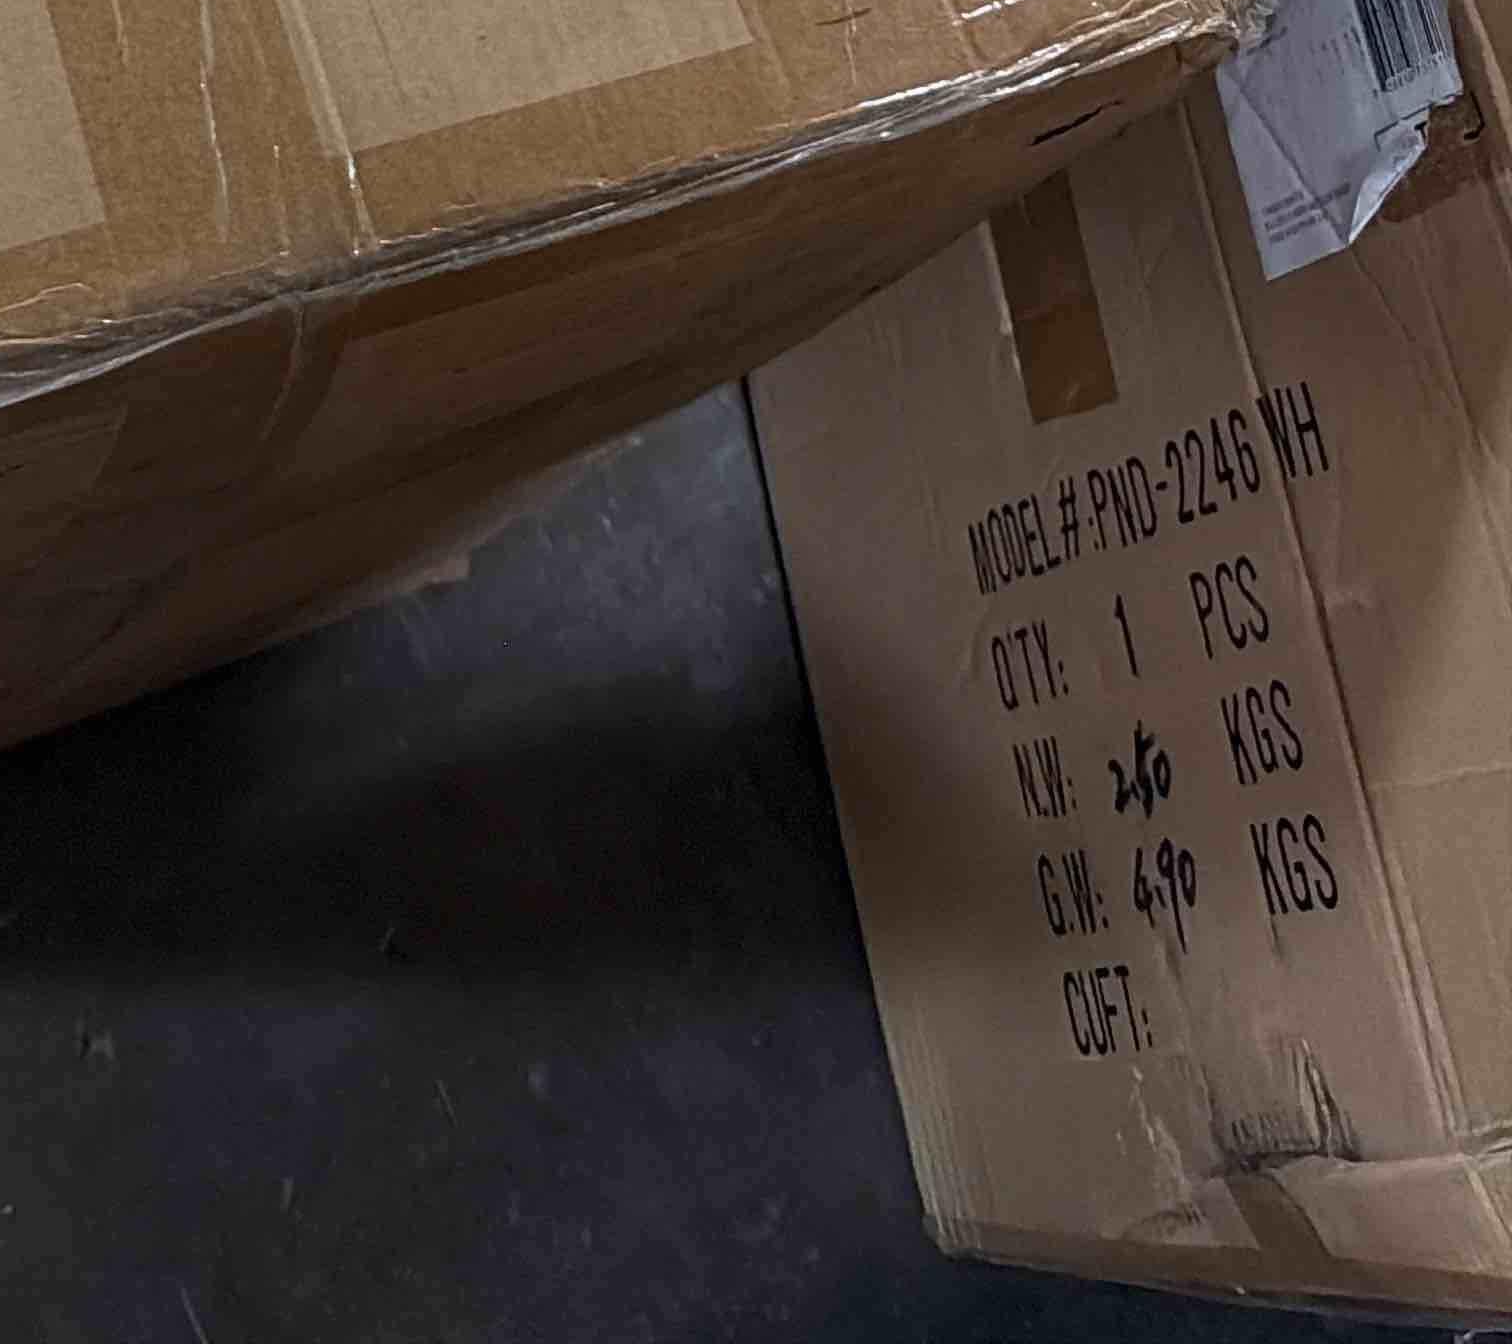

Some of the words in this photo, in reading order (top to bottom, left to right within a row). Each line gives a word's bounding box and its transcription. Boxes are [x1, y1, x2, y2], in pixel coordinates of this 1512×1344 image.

[1112, 593, 1142, 678] 1
[1187, 555, 1272, 661] PCS
[1220, 679, 1305, 786] KGS
[1249, 813, 1340, 917] KGS
[1061, 965, 1155, 1057] CUFT:
